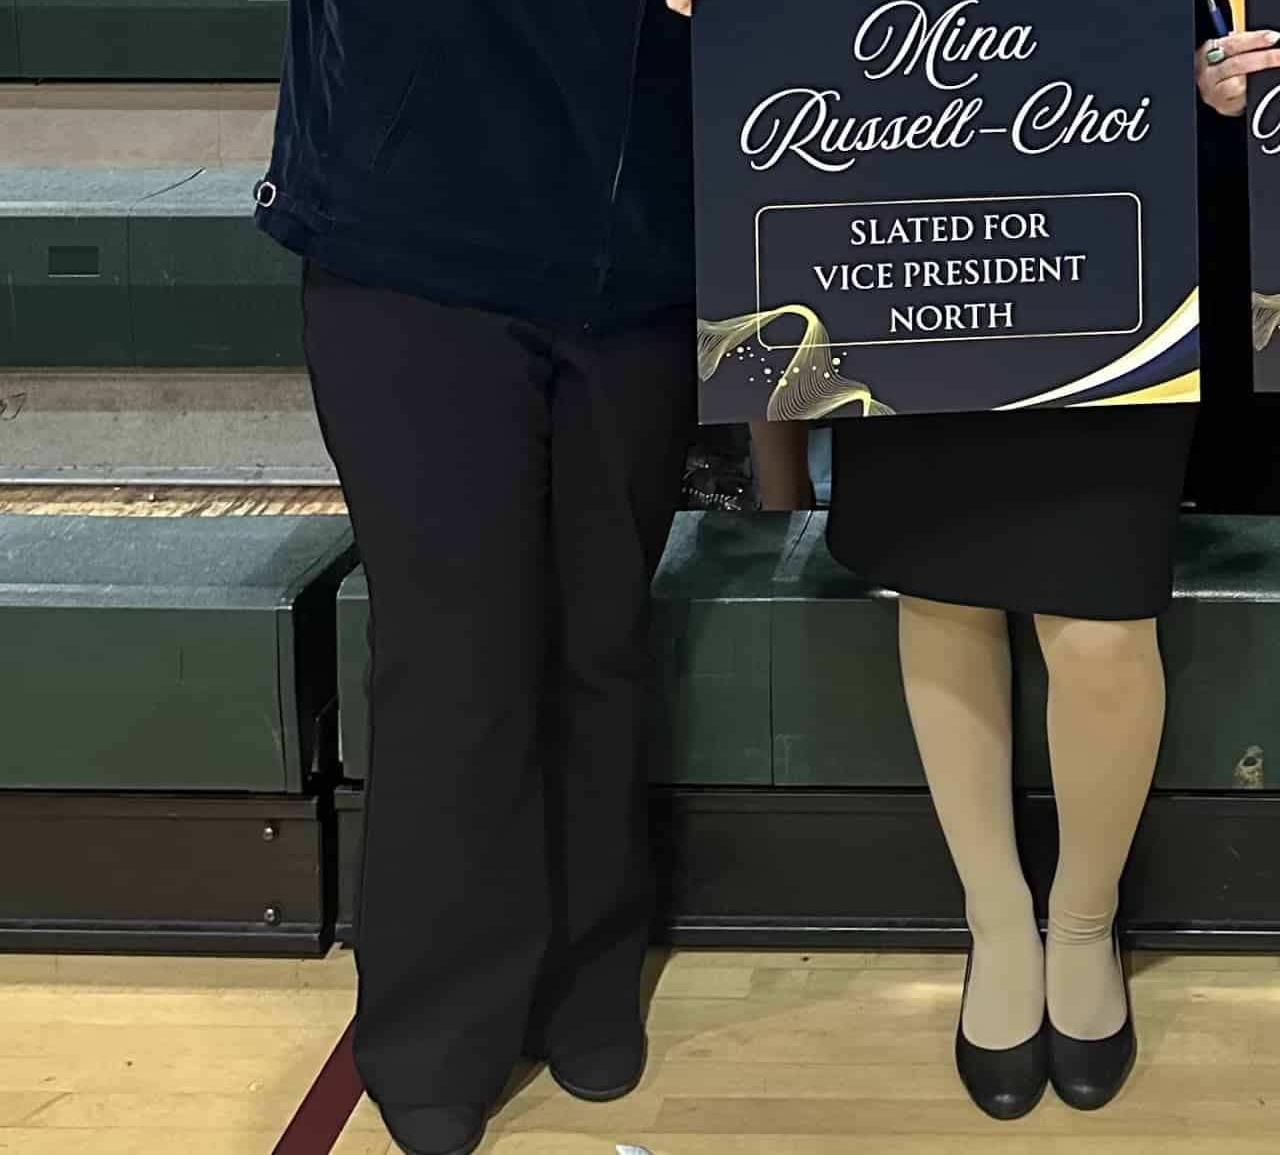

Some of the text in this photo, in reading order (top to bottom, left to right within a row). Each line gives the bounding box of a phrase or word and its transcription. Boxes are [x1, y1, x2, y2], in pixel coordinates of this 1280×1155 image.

[854, 0, 1037, 90] Mina
[740, 81, 1151, 172] Russell-Choi
[851, 213, 1050, 246] SLATED FOR
[813, 254, 1086, 291] VICE PRESIDENT
[890, 302, 1014, 334] NORTH
